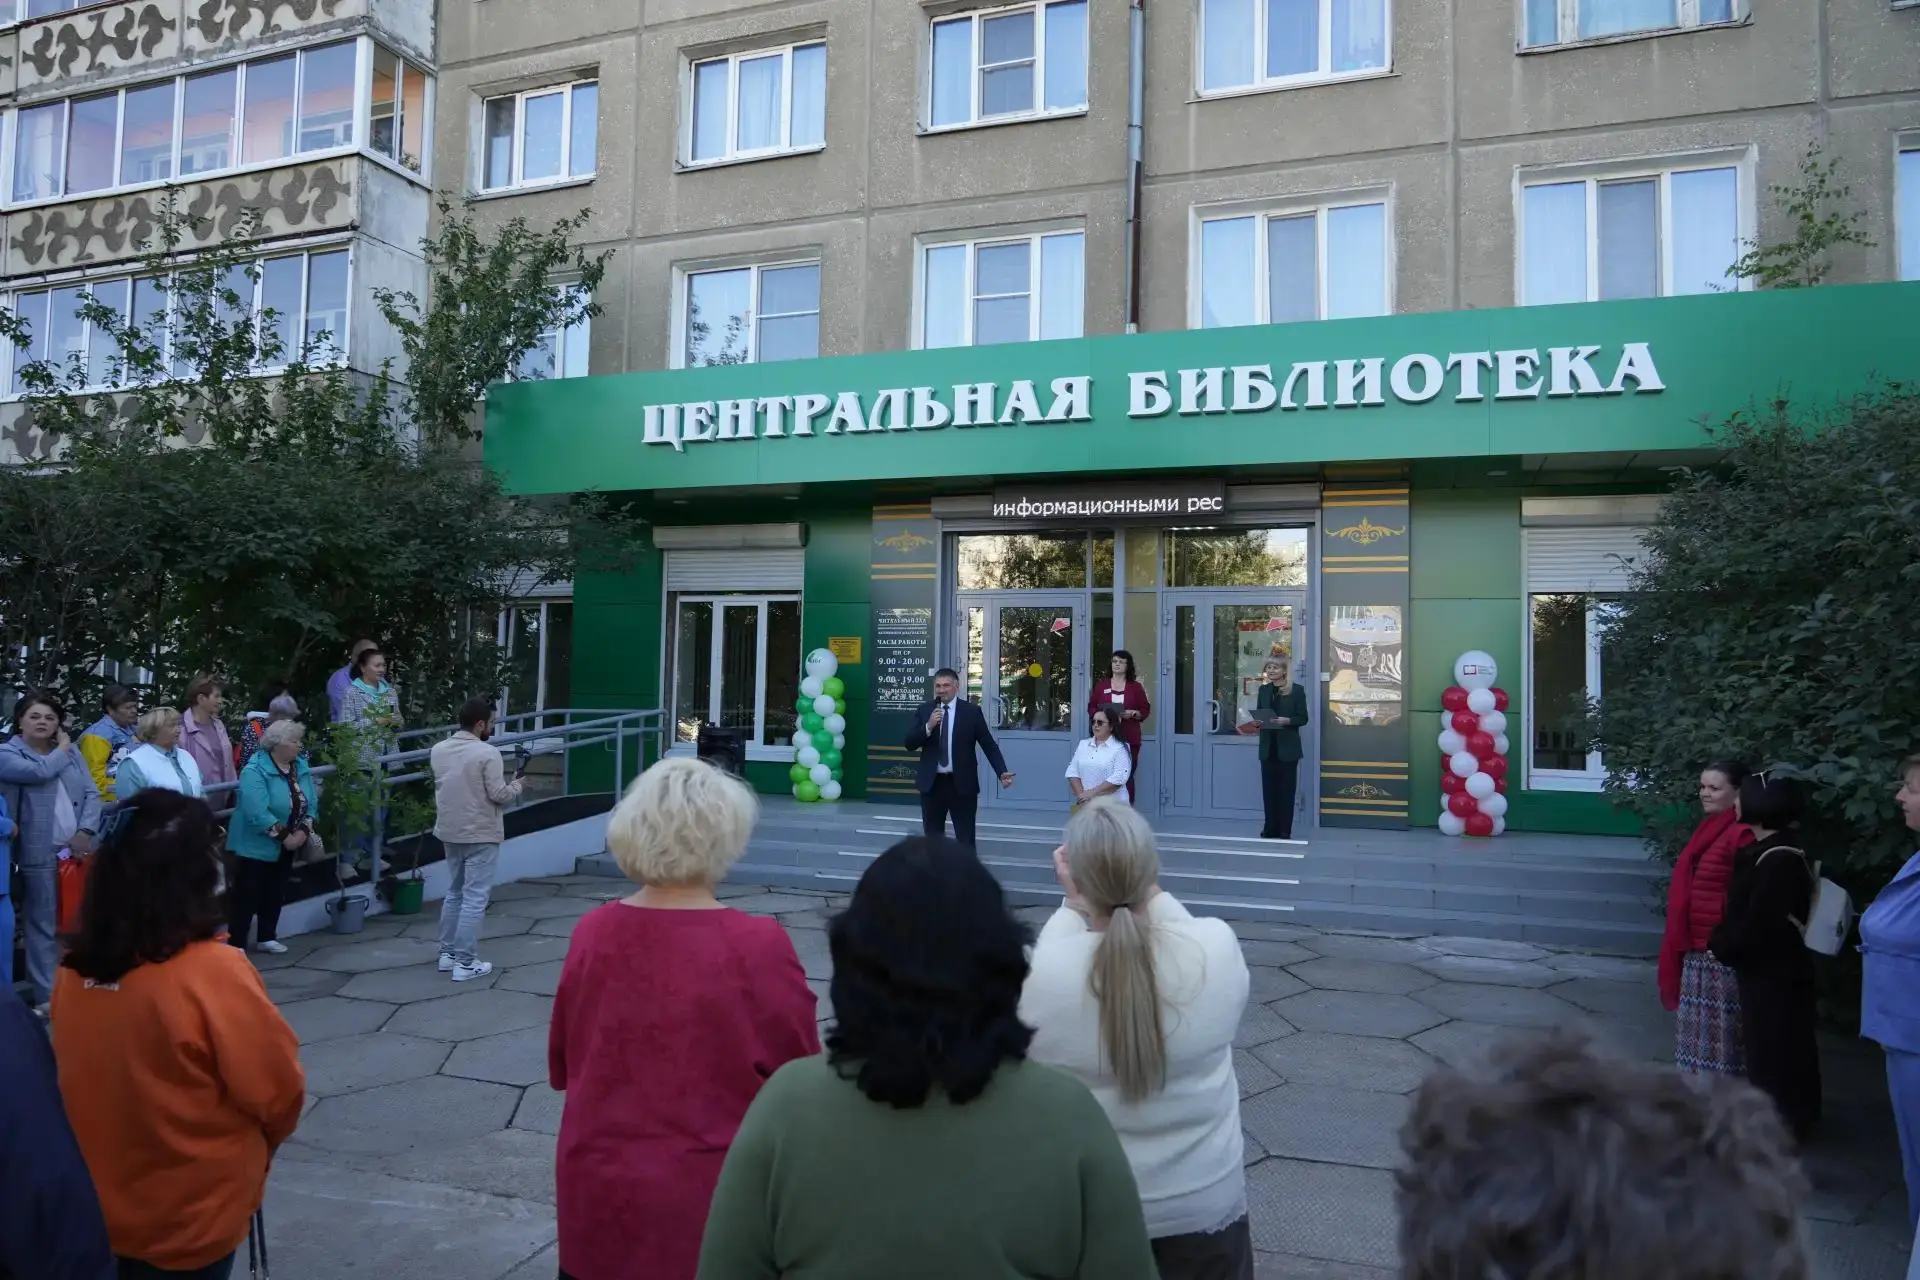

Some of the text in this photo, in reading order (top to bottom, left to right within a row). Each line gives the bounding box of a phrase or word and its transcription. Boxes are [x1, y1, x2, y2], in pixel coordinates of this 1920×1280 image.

[641, 341, 1667, 453] ЦЕНТРАЛЬНАЯ БИБЛИОТЕКА
[993, 496, 1223, 517] информационными рес
[878, 657, 896, 665] 9.00
[902, 657, 925, 665] 20.00
[878, 675, 896, 683] 9.00
[902, 675, 925, 683] 19.00
